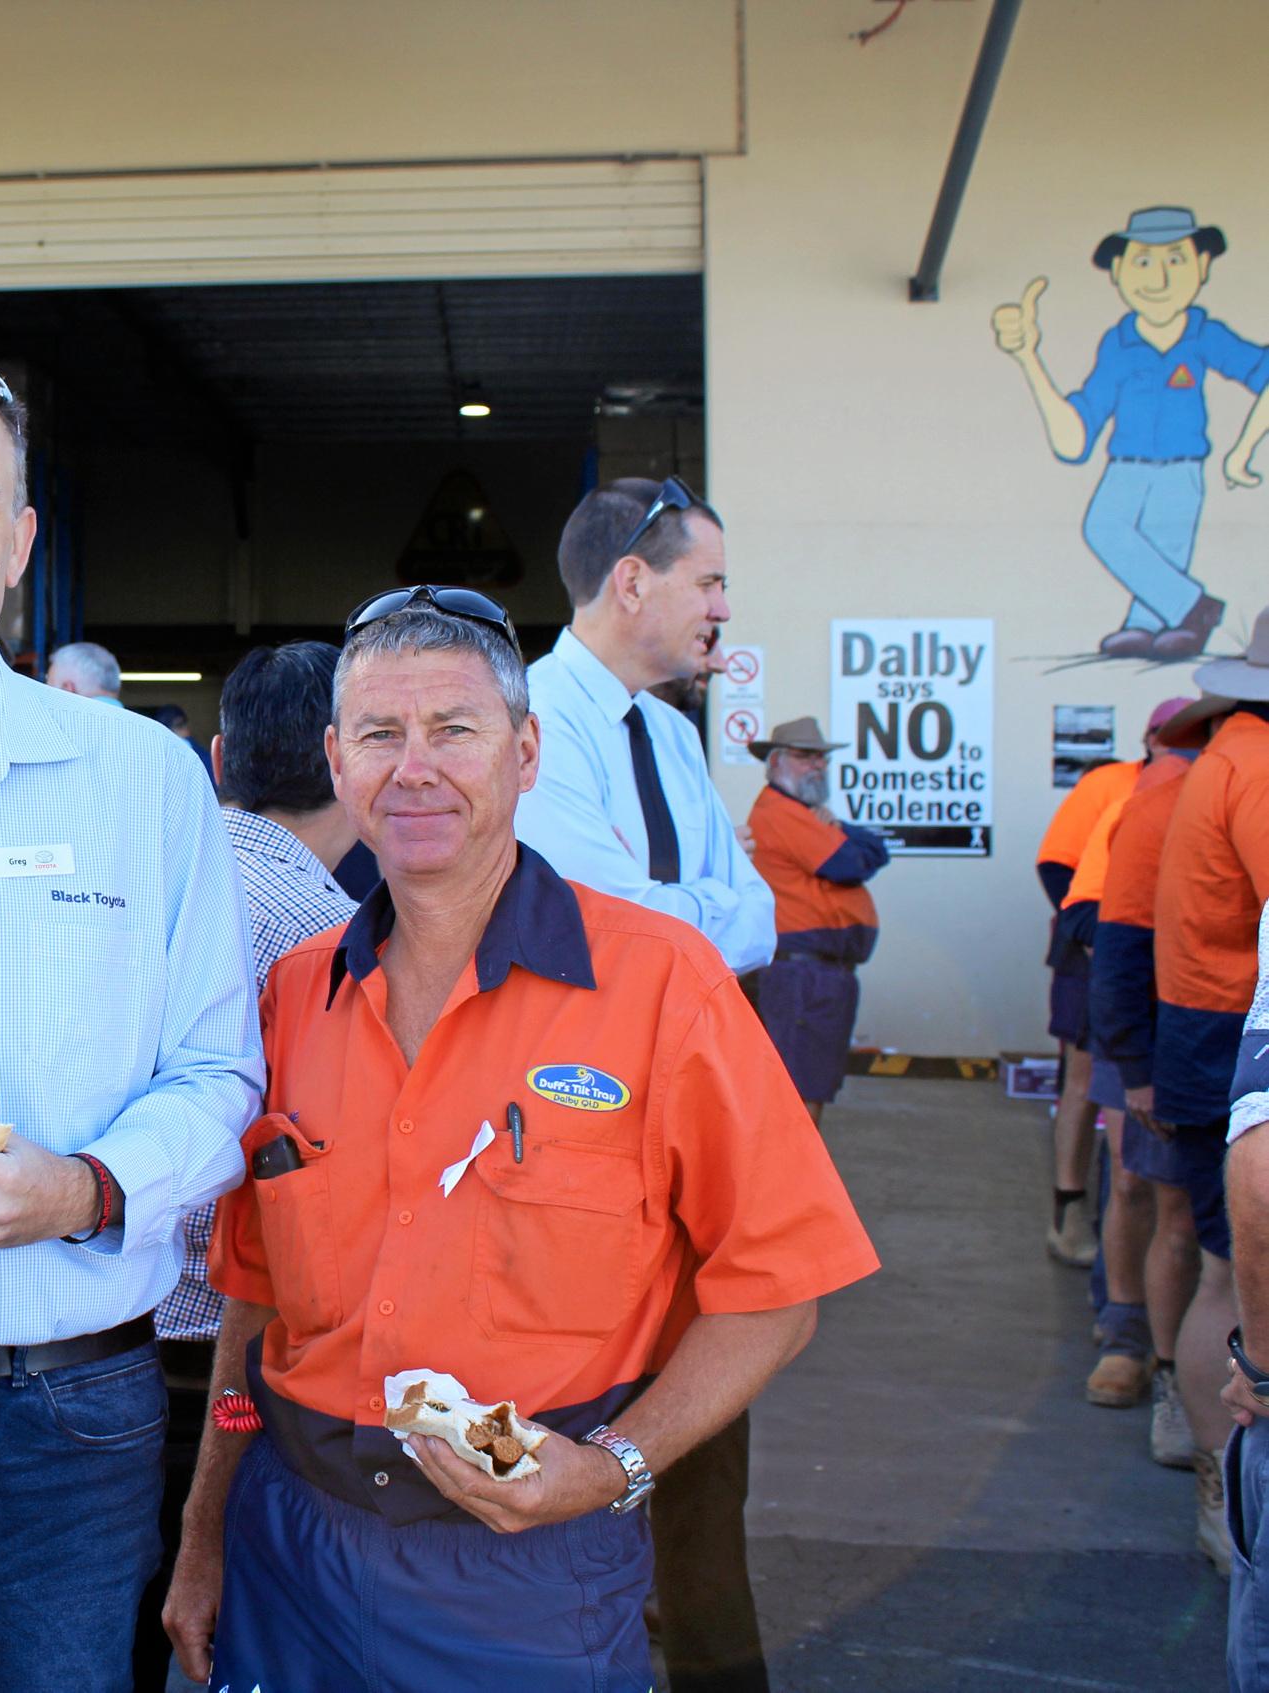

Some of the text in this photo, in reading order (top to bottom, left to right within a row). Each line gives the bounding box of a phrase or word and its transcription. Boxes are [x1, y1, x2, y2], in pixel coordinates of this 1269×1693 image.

[841, 631, 985, 686] Dalby
[877, 681, 934, 701] says
[857, 701, 983, 761] NO to
[840, 764, 985, 791] Domestic
[846, 794, 981, 821] Violence
[9, 858, 27, 867] Greg
[51, 890, 126, 908] Black Toyota
[539, 1078, 616, 1103] Duff's Tilt Tray
[553, 1094, 579, 1106] Dalby
